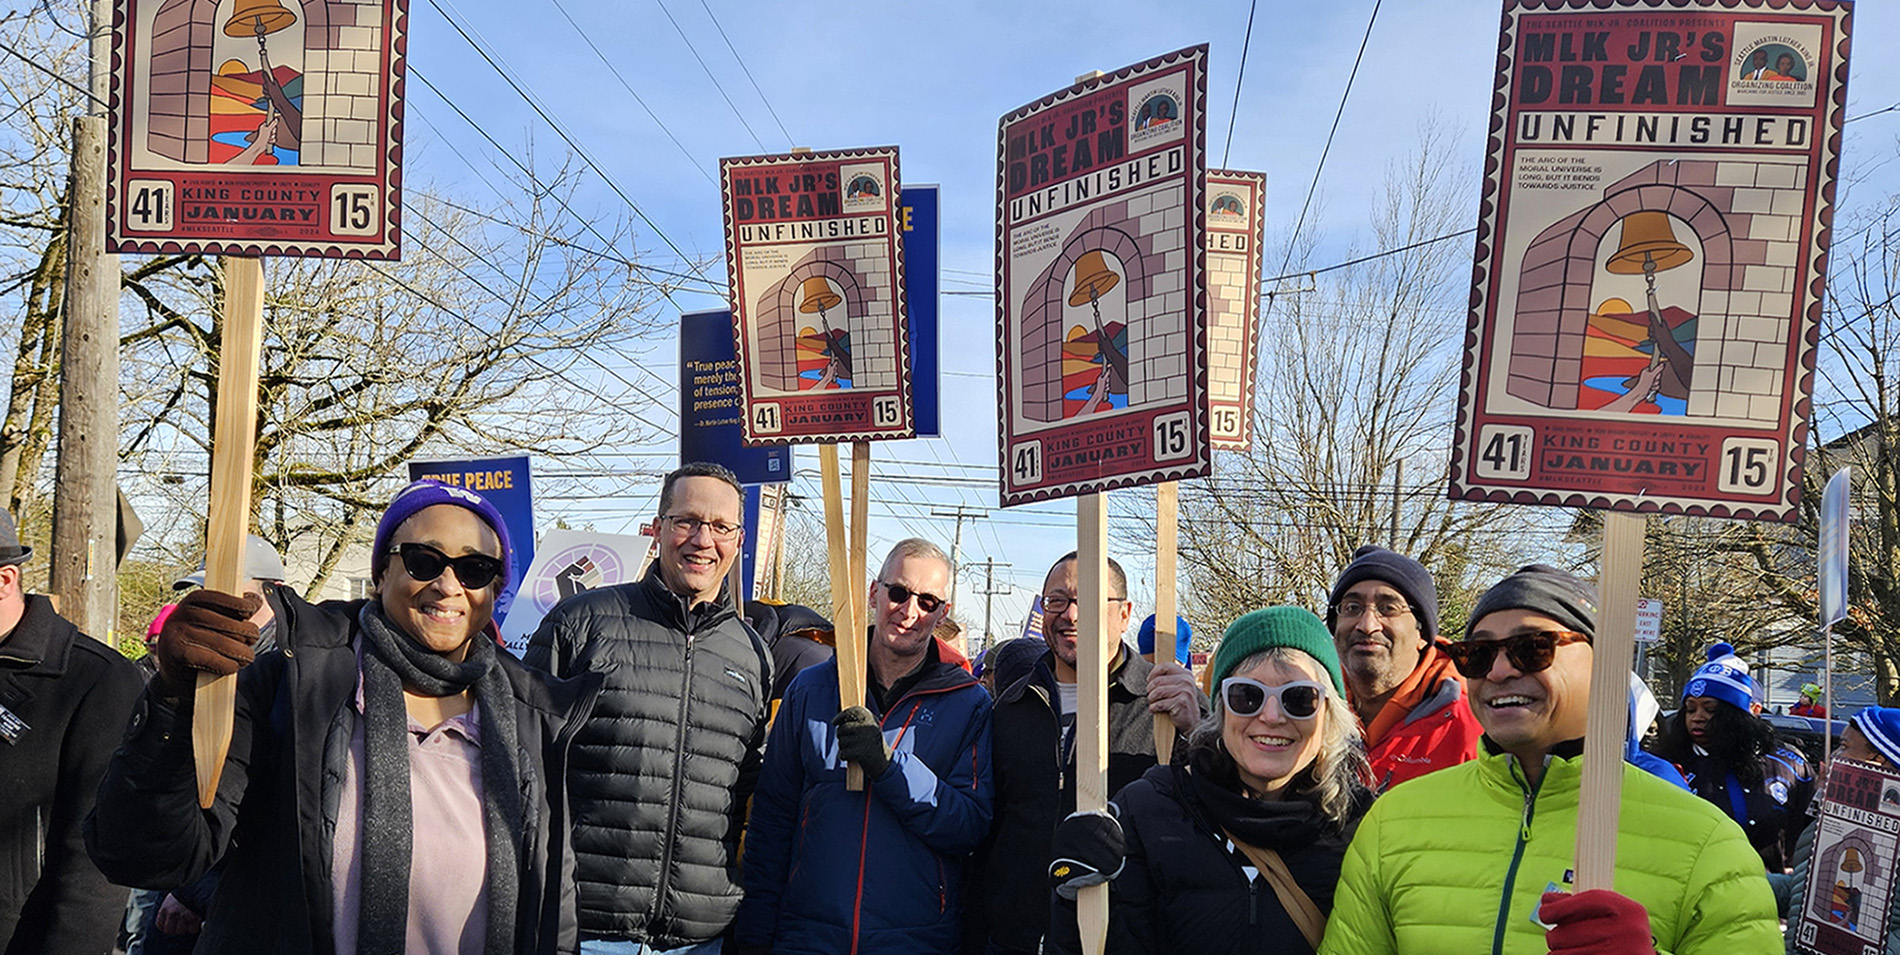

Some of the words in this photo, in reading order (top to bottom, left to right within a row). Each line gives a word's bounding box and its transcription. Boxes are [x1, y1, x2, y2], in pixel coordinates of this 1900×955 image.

[1545, 20, 1583, 28] SEATTLE
[1586, 19, 1604, 28] MLK
[1626, 19, 1676, 28] COALITION
[1679, 18, 1726, 28] PRESENTS
[1523, 31, 1610, 63] MLK
[1627, 31, 1725, 63] JR'S
[1519, 64, 1722, 106] DREAM
[1775, 82, 1813, 91] COALITION
[1010, 123, 1056, 162] MLK
[1065, 100, 1124, 140] JR'S
[1521, 114, 1806, 146] UNFINISHED
[1010, 126, 1124, 194] DREAM
[182, 187, 230, 200] KING
[241, 189, 320, 202] COUNTY
[735, 176, 780, 196] MLK
[789, 172, 837, 193] JR'S
[1013, 149, 1181, 220] UNFINISHED
[1518, 182, 1559, 190] TOWARDS
[132, 187, 163, 224] 41
[186, 205, 315, 221] JANUARY
[335, 191, 370, 230] 15
[738, 192, 839, 220] DREAM
[742, 217, 885, 242] UNFINISHED
[714, 360, 736, 371] peac
[694, 374, 723, 385] merely
[693, 386, 703, 397] of
[694, 398, 733, 411] presence
[785, 403, 814, 413] KING
[820, 401, 867, 411] COUNTY
[875, 400, 897, 423] 15
[756, 407, 775, 429] 41
[789, 411, 865, 424] JANUARY
[1214, 410, 1235, 433] 15
[1047, 437, 1080, 453] KING
[1087, 425, 1146, 446] COUNTY
[1156, 419, 1185, 455] 15
[1543, 435, 1600, 449] KING
[1613, 438, 1710, 455] COUNTY
[1015, 446, 1035, 479] 41
[1051, 442, 1142, 469] JANUARY
[1482, 432, 1522, 472] 41
[1547, 454, 1701, 477] JANUARY
[1727, 446, 1768, 488] 15
[465, 470, 513, 490] PEACE
[1825, 800, 1899, 832] UNFINISHED
[1802, 925, 1815, 942] 41
